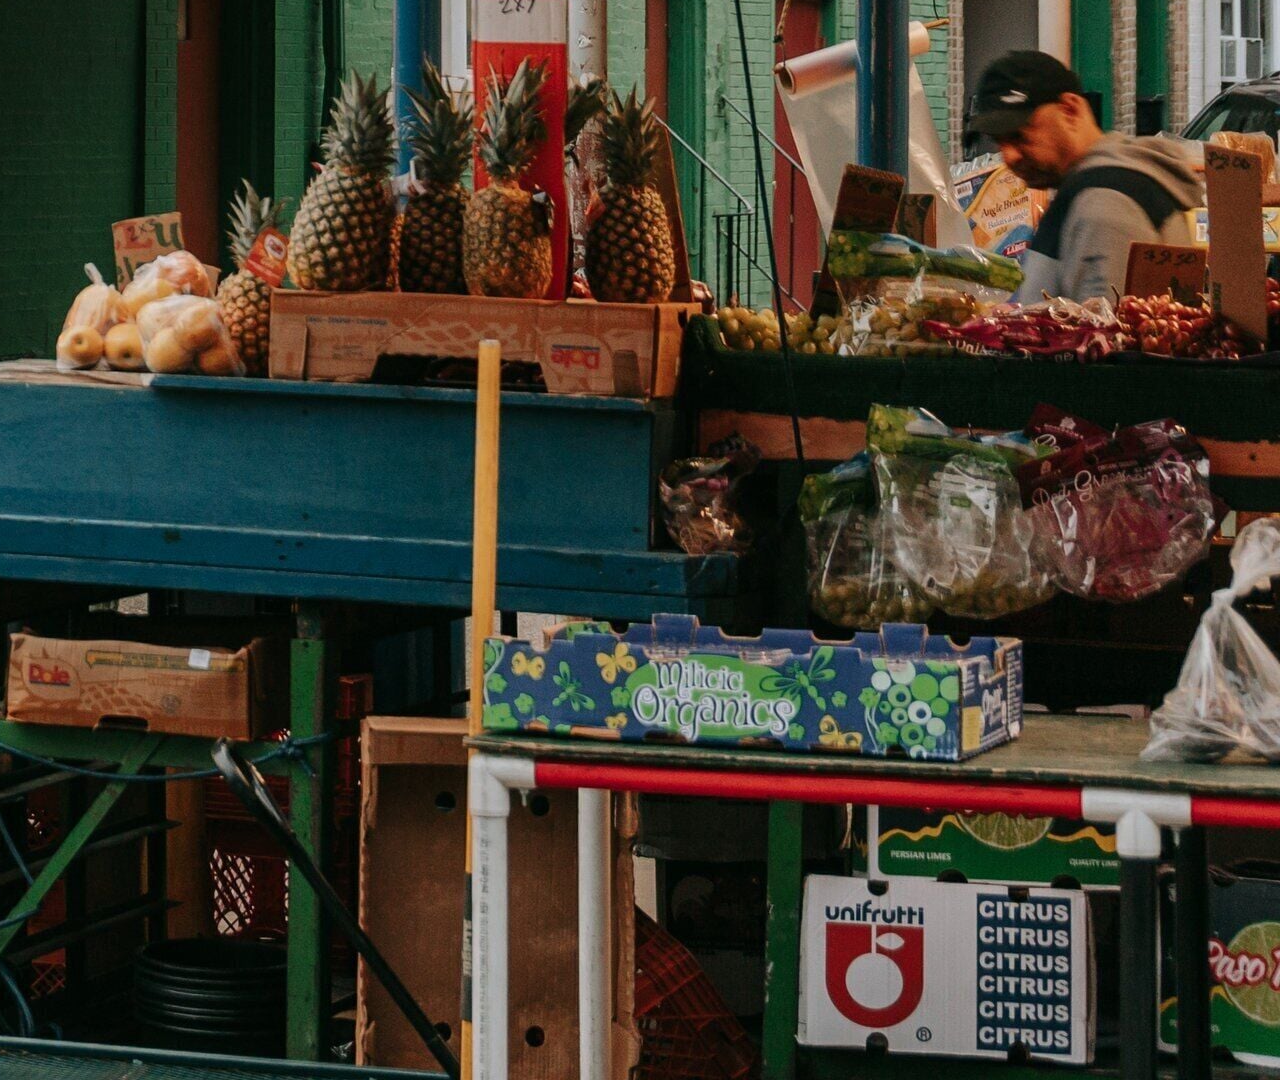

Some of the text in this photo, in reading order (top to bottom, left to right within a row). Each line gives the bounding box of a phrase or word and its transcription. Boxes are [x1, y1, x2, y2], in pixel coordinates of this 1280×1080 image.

[981, 195, 1029, 218] Angle Broom
[29, 663, 70, 684] Dole
[649, 659, 743, 699] Milicic
[632, 692, 794, 742] Organics
[890, 850, 952, 862] PERSIAN LIMES
[1068, 858, 1100, 867] QUALITY
[825, 899, 924, 925] unifrutti
[979, 900, 1069, 922] CITRUS
[979, 926, 1069, 948] CITRUS
[979, 951, 1069, 973] CITRUS
[1208, 939, 1267, 984] Paso
[979, 976, 1069, 997] CITRUS
[979, 1001, 1069, 1023] CITRUS
[979, 1026, 1069, 1048] CITRUS
